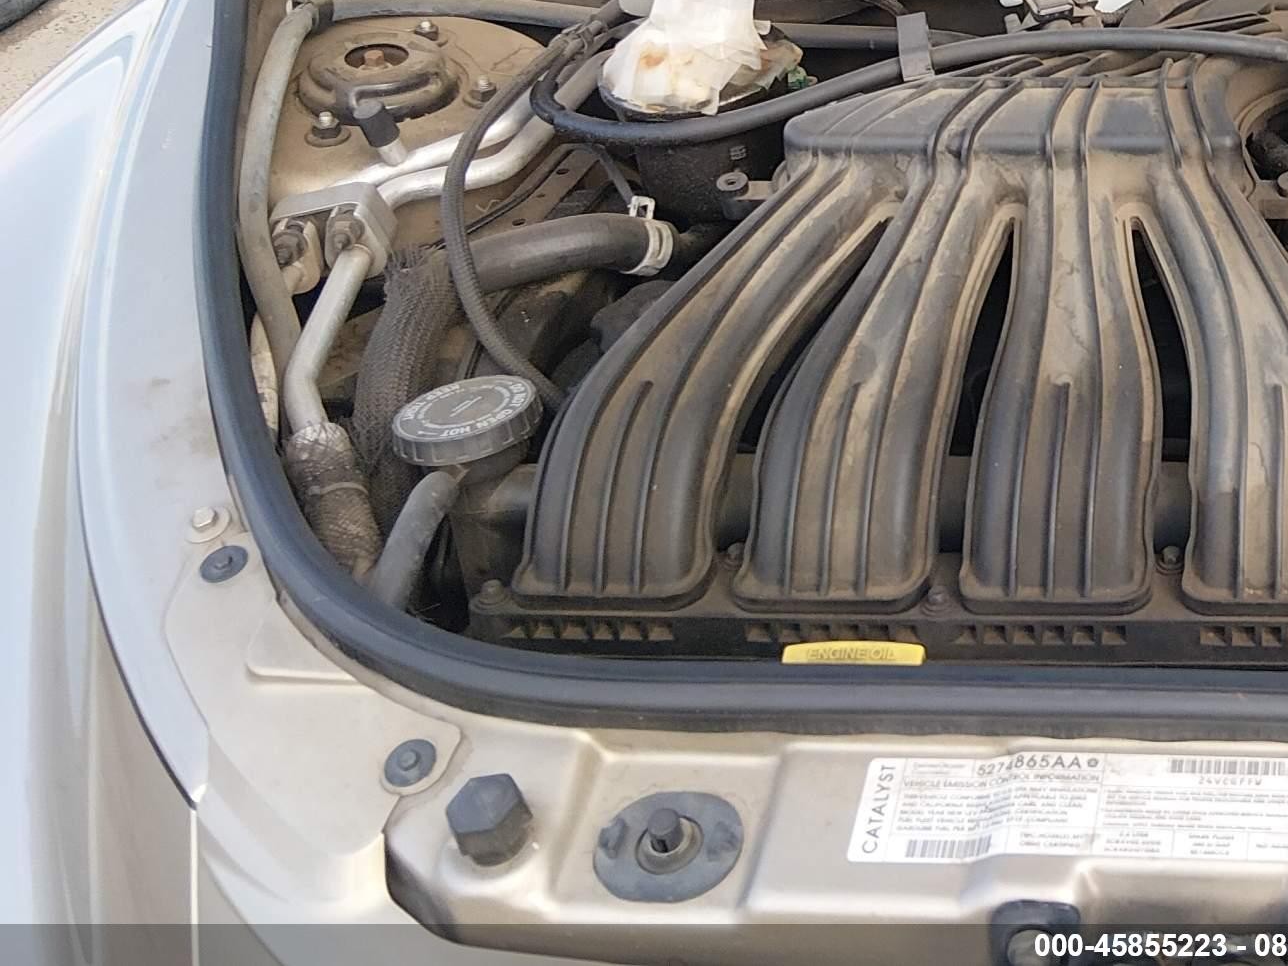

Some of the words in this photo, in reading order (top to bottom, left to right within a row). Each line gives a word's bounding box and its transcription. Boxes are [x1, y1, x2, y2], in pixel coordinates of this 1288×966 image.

[439, 425, 473, 438] HOT
[807, 647, 866, 660] ENGINE
[868, 648, 897, 661] OIL
[976, 753, 1082, 777] 5274865AA
[903, 777, 941, 787] VEHICLE
[943, 778, 987, 788] EMISSION
[862, 763, 897, 854] CATALYST
